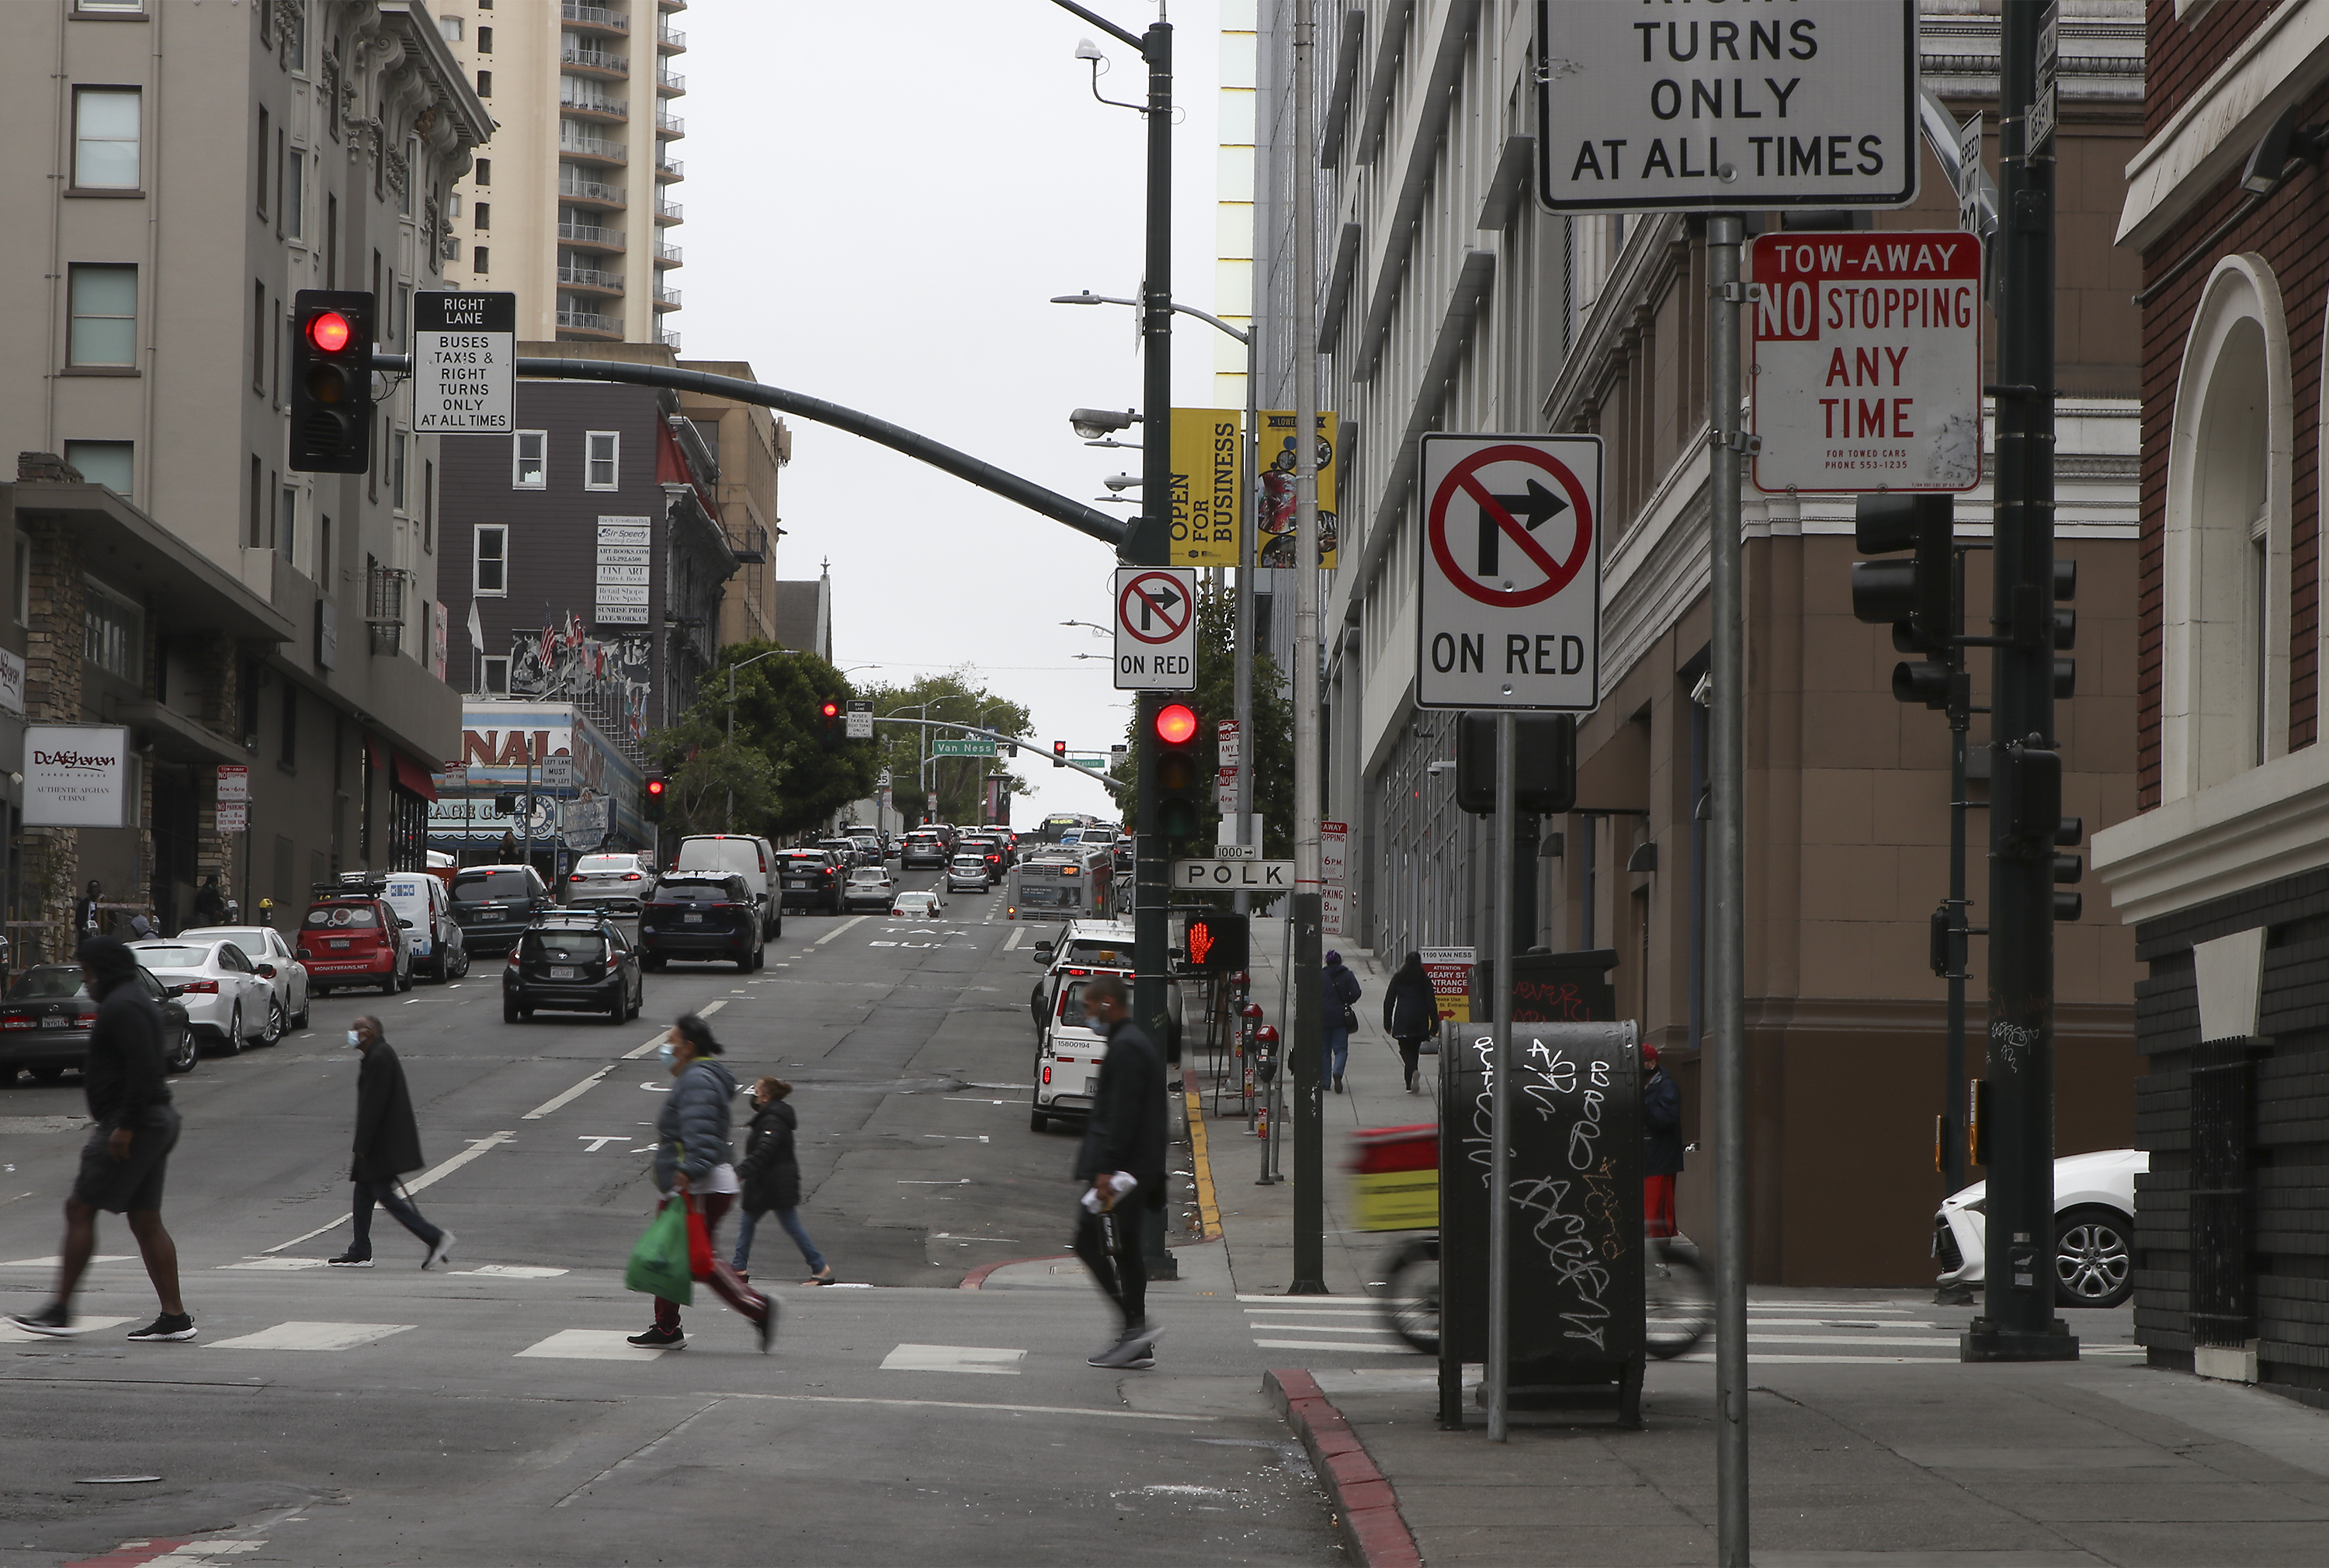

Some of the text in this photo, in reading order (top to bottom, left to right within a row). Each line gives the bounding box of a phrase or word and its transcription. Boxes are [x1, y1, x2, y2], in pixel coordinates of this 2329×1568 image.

[1633, 19, 1817, 62] TURNS
[1650, 77, 1801, 120] ONLY
[2031, 96, 2050, 141] GEARY
[1571, 134, 1884, 181] AT ALL TIMES
[1961, 134, 1980, 169] SPEED
[1961, 168, 1977, 201] LIMIT
[1775, 244, 1958, 272] TOW-AWAY
[444, 298, 485, 310] RIGHT
[1758, 281, 1971, 337] NO STOPPING
[446, 312, 483, 324] LANE
[439, 336, 489, 348] BUSES
[484, 352, 494, 363] &
[1825, 346, 1910, 387] ANY
[441, 368, 487, 380] RIGHT
[439, 383, 489, 395] TURNS
[443, 399, 484, 411] ONLY
[421, 415, 506, 426] AT ALL TIMES
[1819, 398, 1914, 438] TIME
[1213, 423, 1234, 543] BUSINESS
[1170, 472, 1189, 542] OPEN
[1192, 499, 1209, 543] FOR
[619, 530, 648, 539] Speedy
[1432, 632, 1584, 675] ON RED
[1121, 655, 1189, 675] ON RED
[938, 743, 991, 752] Van Ness
[1220, 776, 1230, 785] NO
[1218, 847, 1242, 857] 1000
[1189, 865, 1283, 884] POLK
[1058, 1040, 1090, 1049] 15800194
